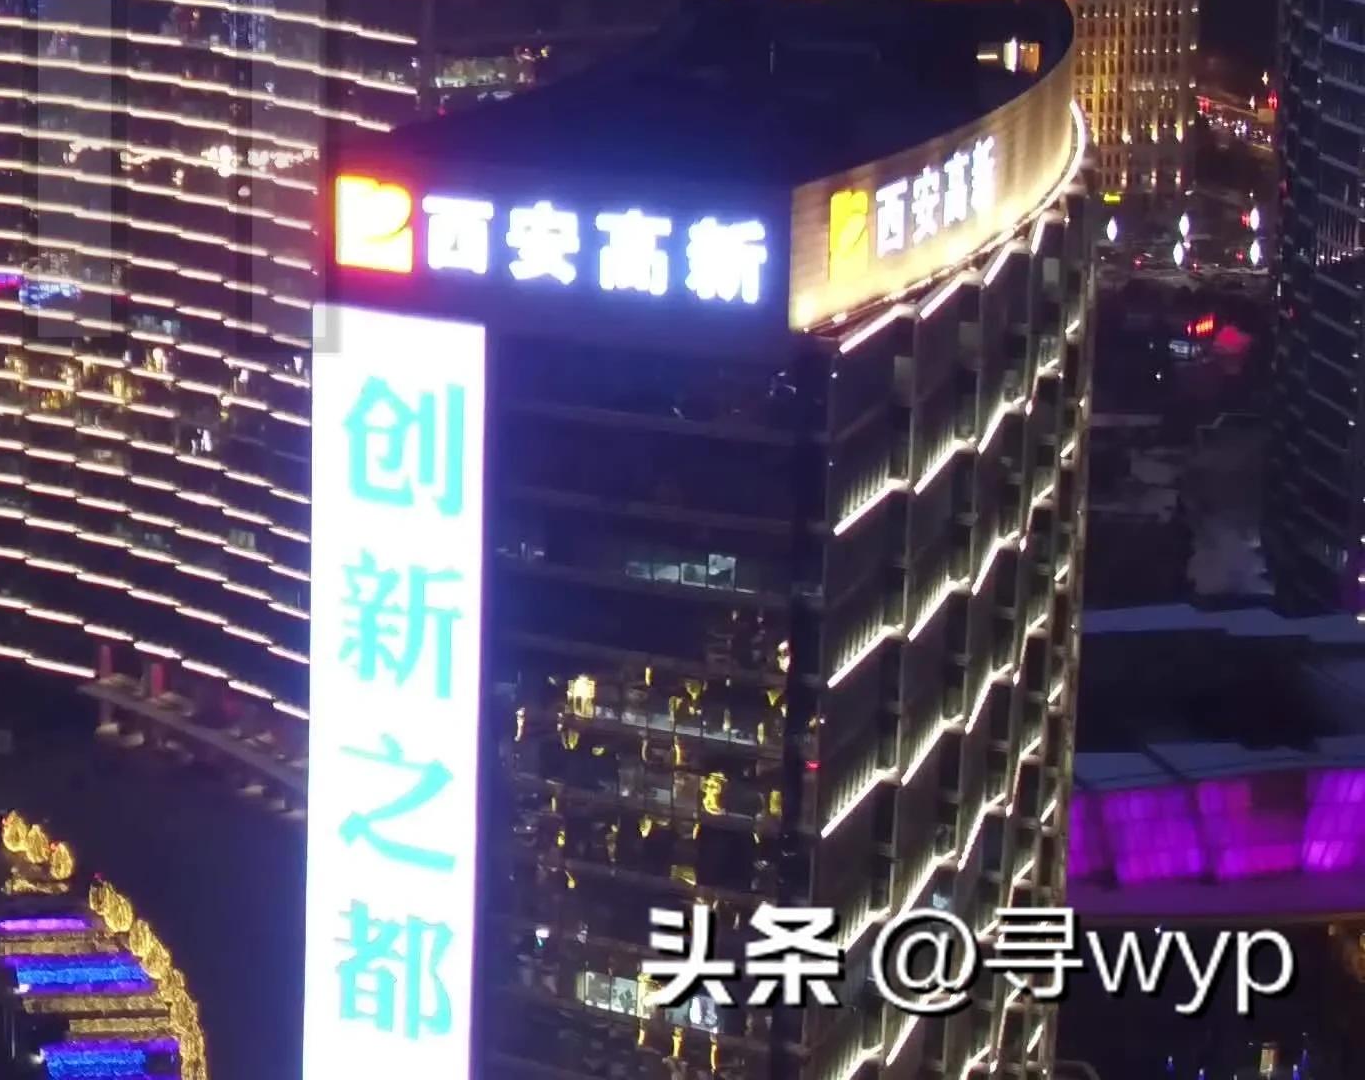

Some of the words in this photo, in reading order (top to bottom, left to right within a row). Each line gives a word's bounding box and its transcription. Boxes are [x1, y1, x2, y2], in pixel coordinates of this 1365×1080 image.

[423, 196, 767, 302] 西安高新
[875, 137, 996, 253] 西安高新
[336, 375, 464, 1040] 创新之都
